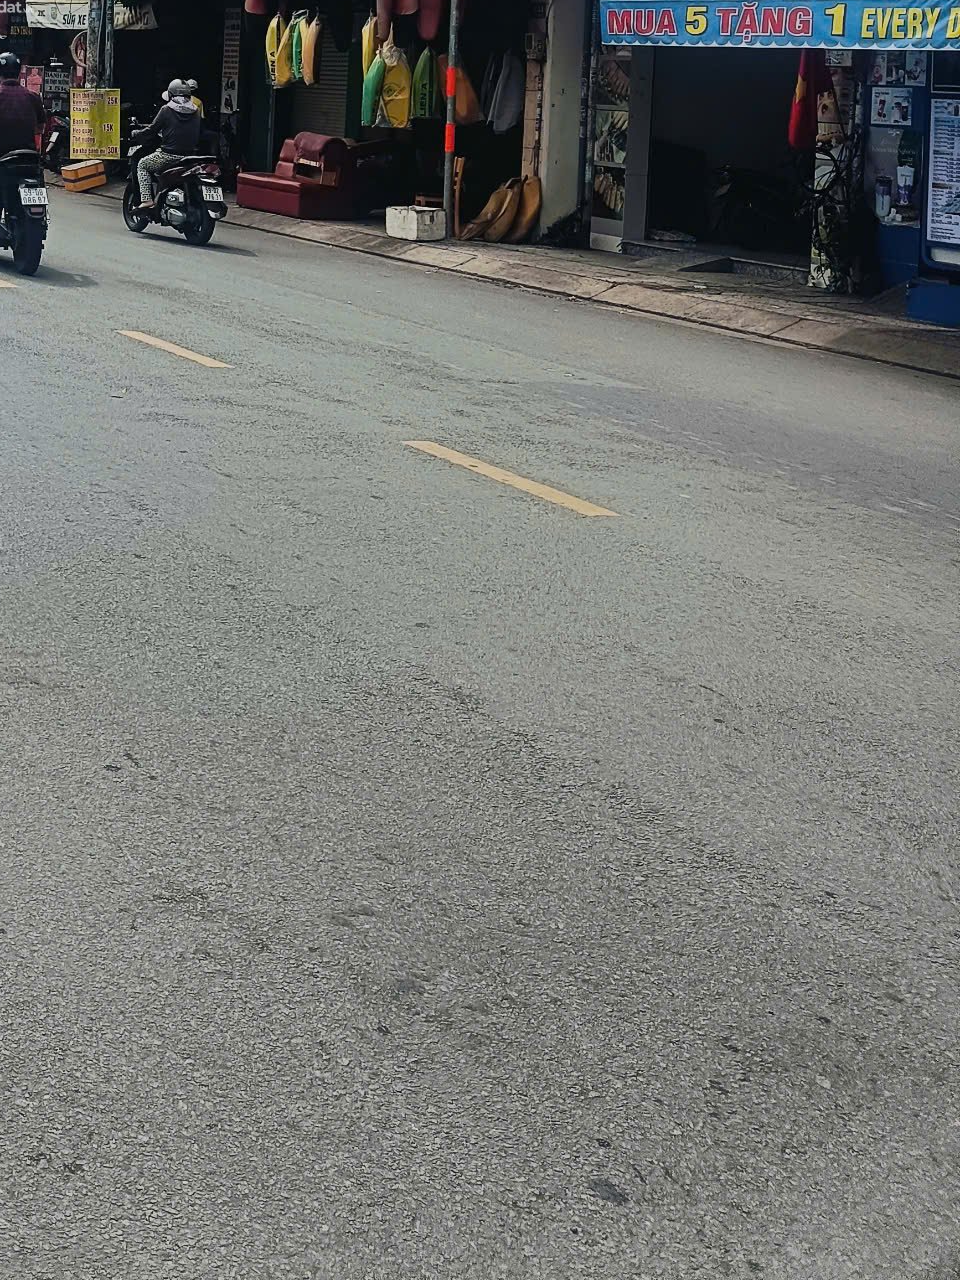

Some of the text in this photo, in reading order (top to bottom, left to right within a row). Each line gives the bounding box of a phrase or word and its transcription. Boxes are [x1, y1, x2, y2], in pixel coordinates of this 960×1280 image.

[78, 14, 87, 25] XE
[606, 8, 678, 36] MUA
[685, 6, 708, 35] 5
[715, 2, 813, 43] TẶNG
[824, 3, 847, 36] 1
[861, 5, 943, 40] EVERY
